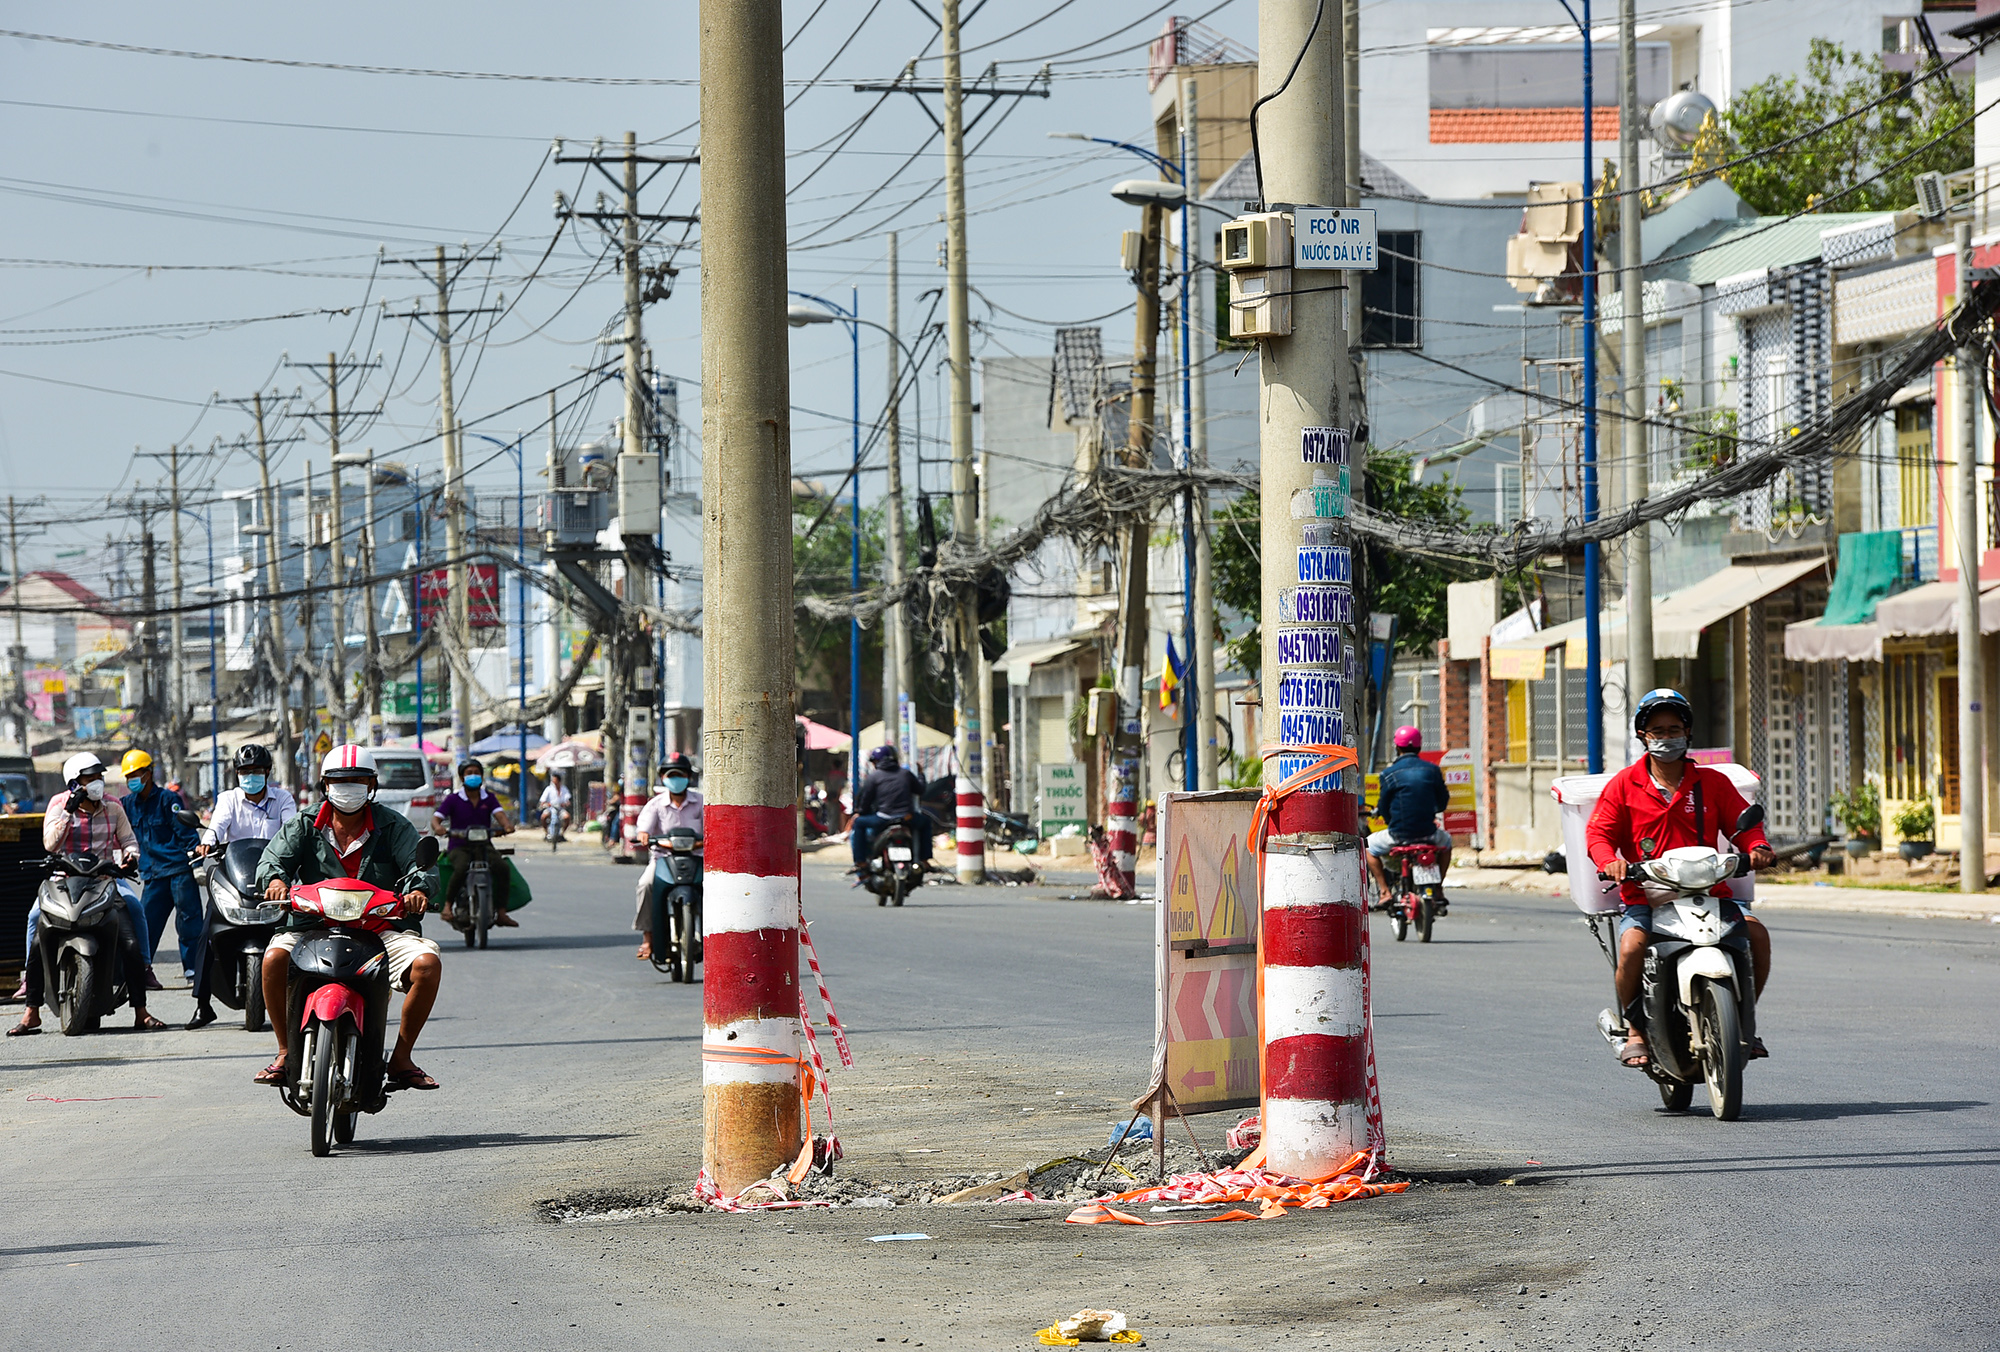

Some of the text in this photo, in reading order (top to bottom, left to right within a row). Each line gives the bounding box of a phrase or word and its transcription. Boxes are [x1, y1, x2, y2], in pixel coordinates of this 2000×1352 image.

[1310, 218, 1360, 235] FCO NR
[1301, 241, 1372, 262] NƯỚC ĐÁ LÝ É
[1278, 632, 1339, 665] 0945.700.500
[1279, 678, 1341, 709] 0976.150.170
[1280, 714, 1342, 746] 0945.700.500
[1052, 767, 1075, 779] NHÀ
[1045, 783, 1083, 797] THUỐC
[1053, 803, 1076, 816] TÂY
